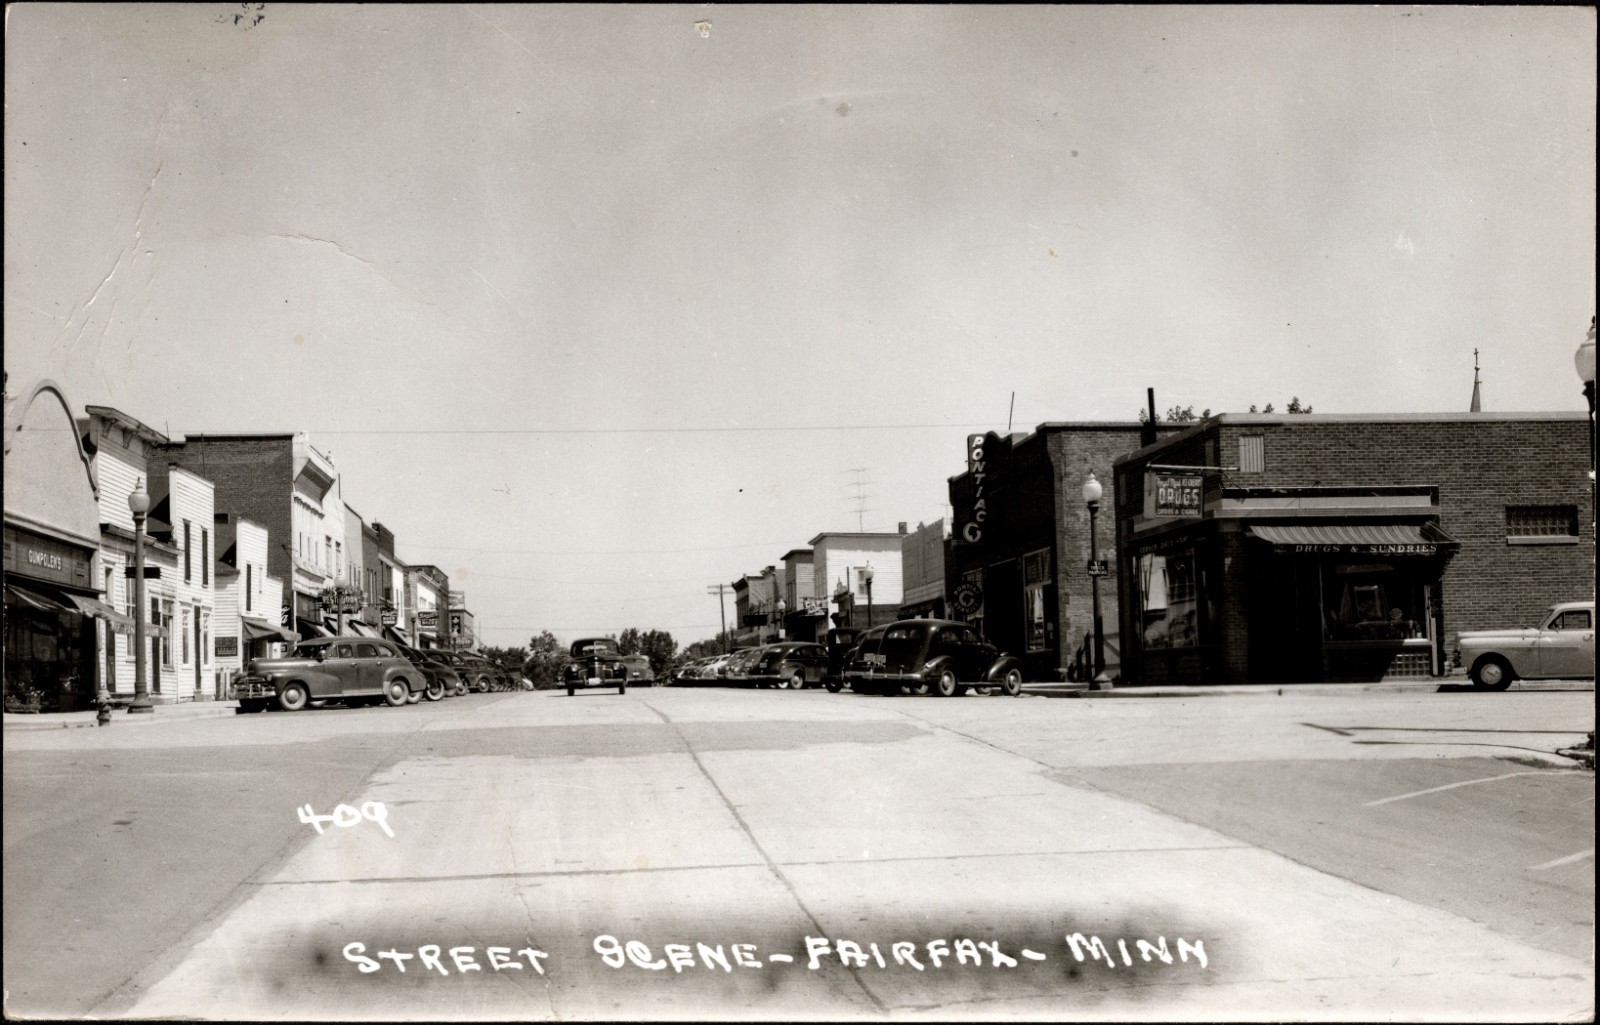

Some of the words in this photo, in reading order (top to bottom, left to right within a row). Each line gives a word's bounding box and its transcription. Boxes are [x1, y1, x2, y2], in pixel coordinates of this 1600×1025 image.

[972, 435, 987, 523] PONTIAC
[1158, 488, 1200, 506] DRUGS
[1295, 544, 1341, 553] DRUGS
[1350, 545, 1359, 553] &
[1369, 544, 1438, 554] SUNDRIES
